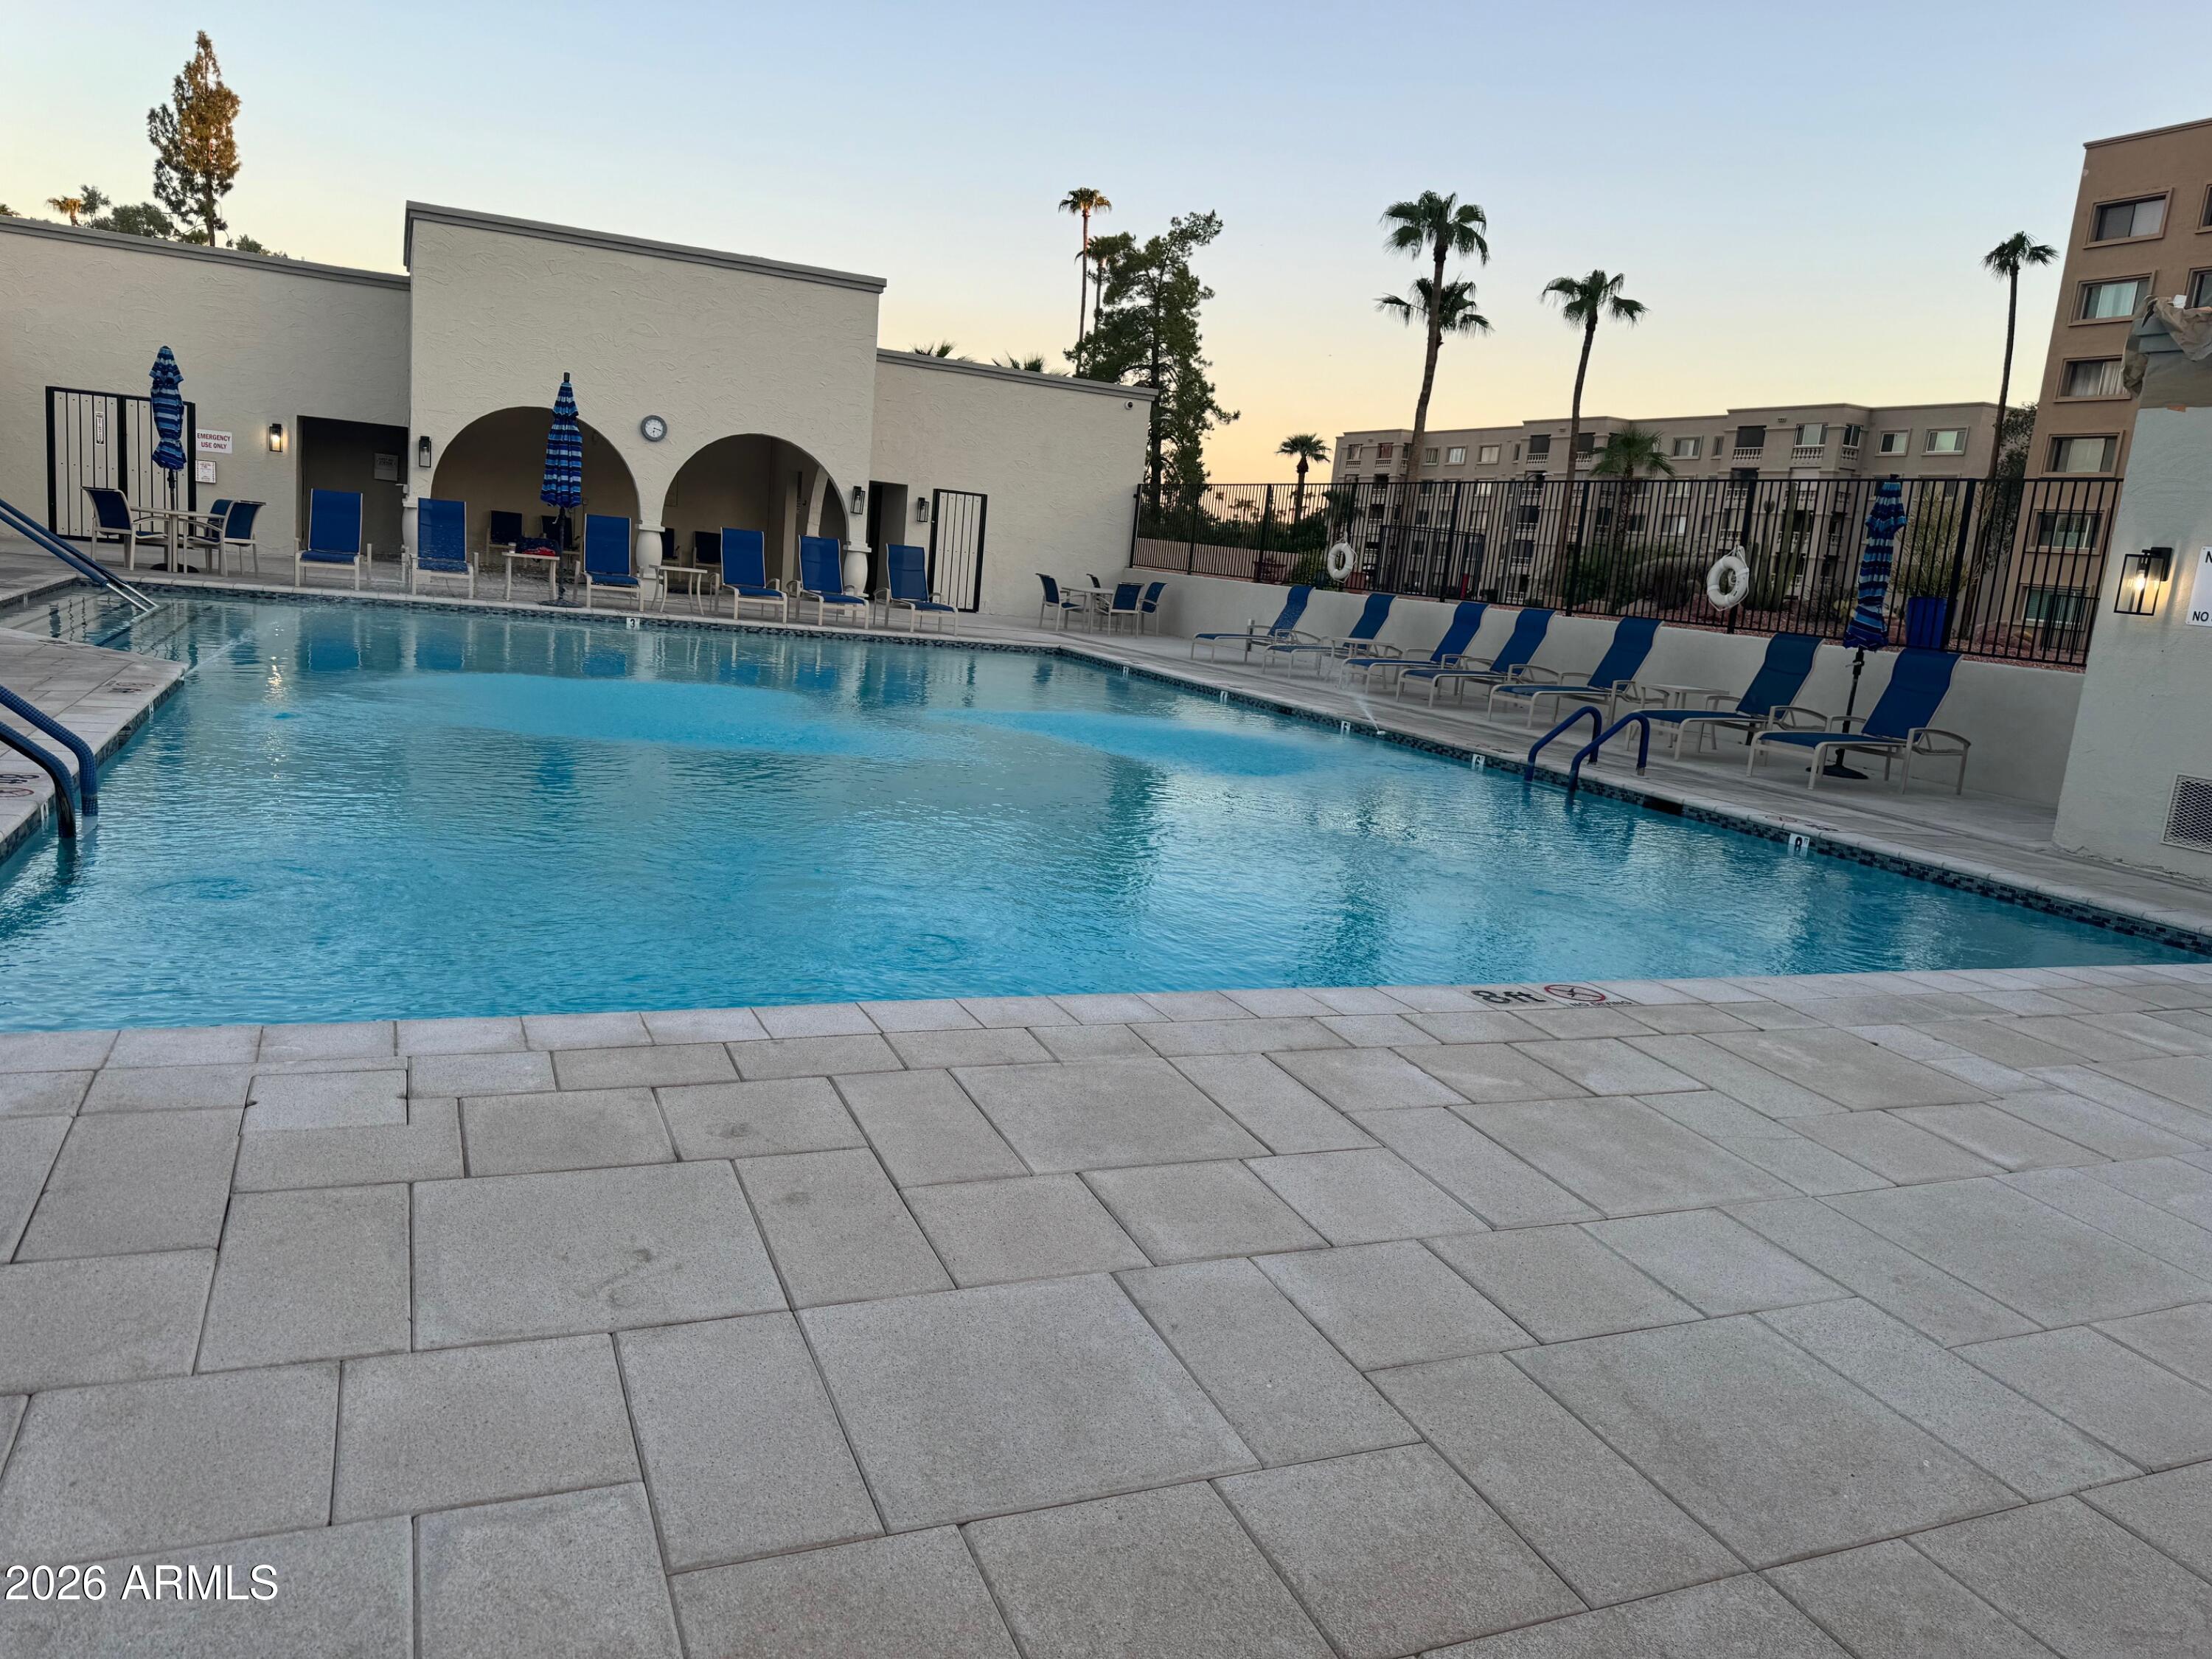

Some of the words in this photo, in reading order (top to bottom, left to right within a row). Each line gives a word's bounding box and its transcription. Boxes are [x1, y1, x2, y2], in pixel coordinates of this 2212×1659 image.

[197, 433, 230, 442] EMERGENCY
[2192, 611, 2209, 622] NO
[630, 619, 635, 627] 3
[1471, 990, 1546, 1004] 8ft
